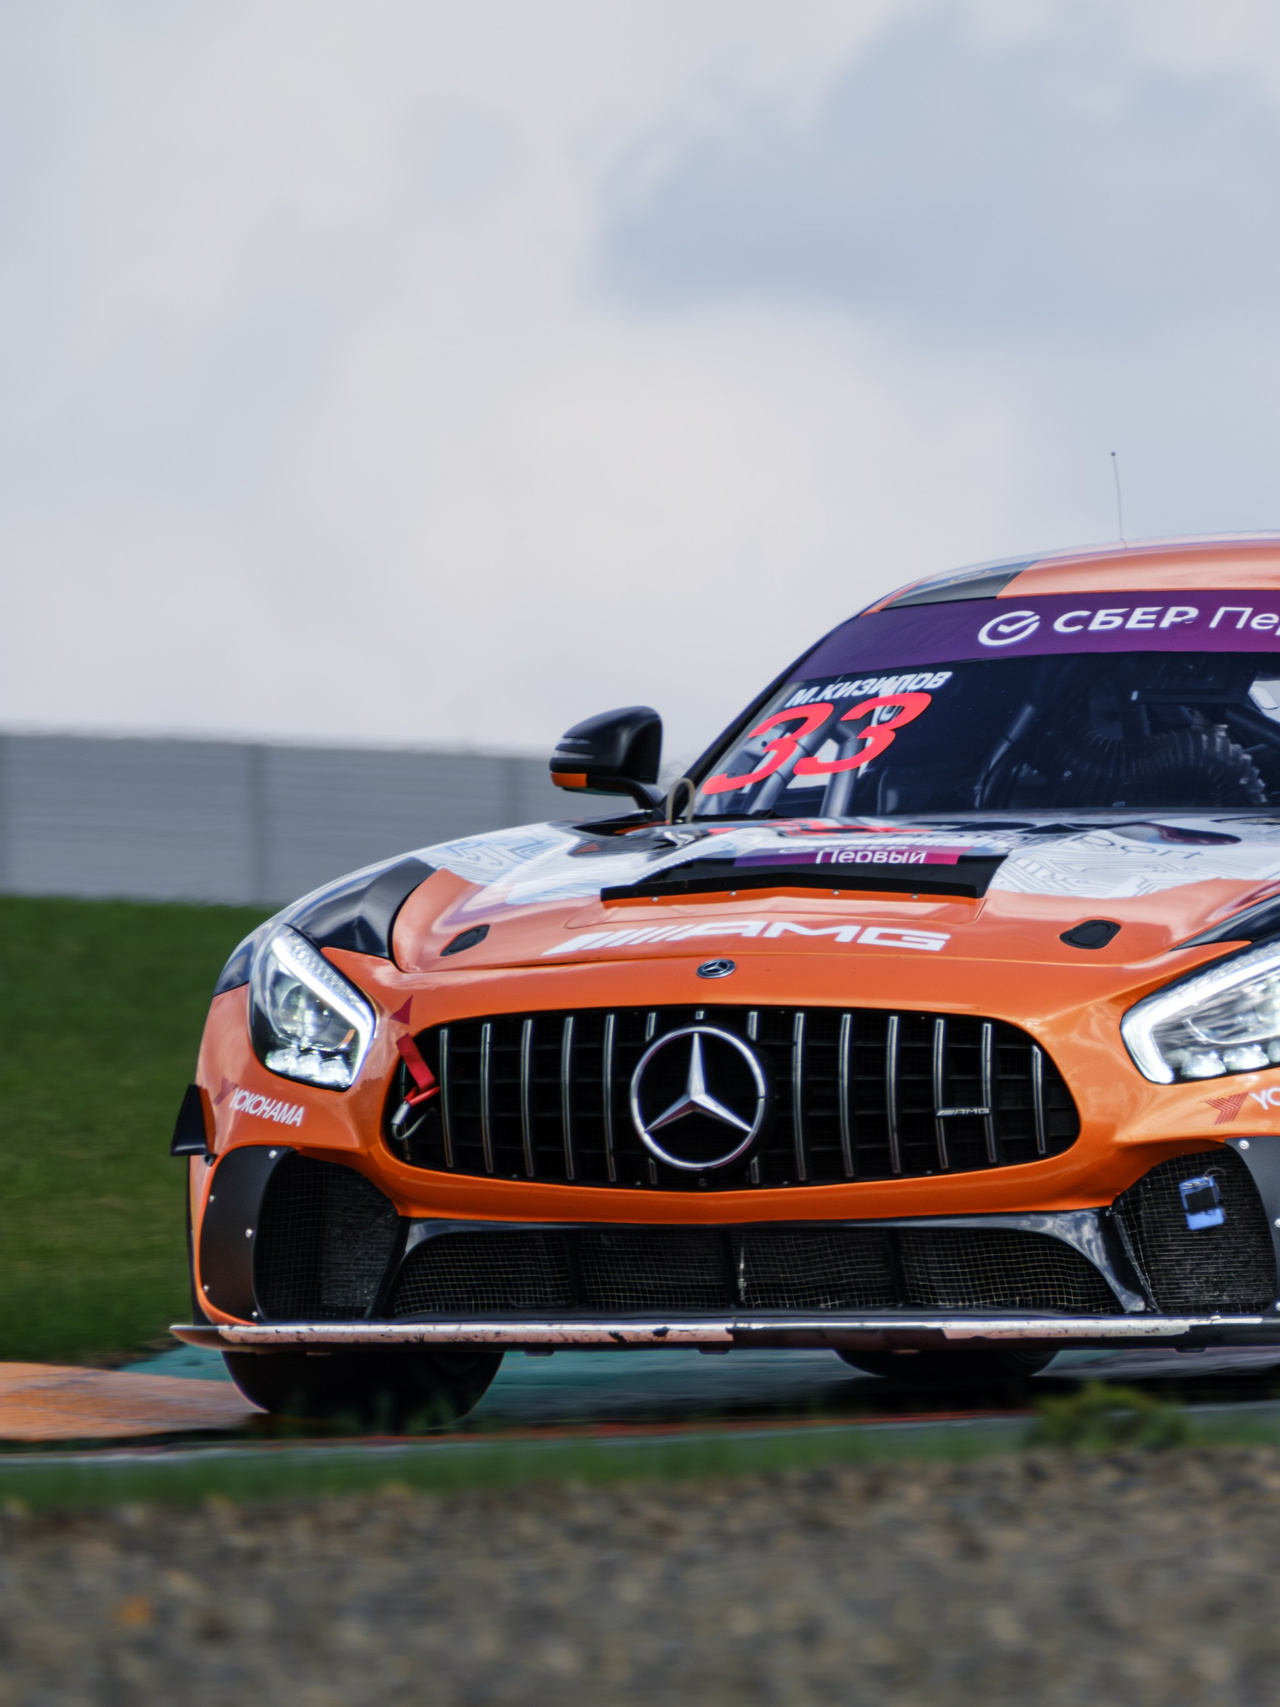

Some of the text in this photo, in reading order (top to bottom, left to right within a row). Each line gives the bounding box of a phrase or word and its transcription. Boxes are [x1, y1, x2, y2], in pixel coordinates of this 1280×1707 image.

[1053, 606, 1199, 632] СБЕР
[701, 692, 932, 795] 33
[229, 1087, 305, 1127] YOKOHAMA
